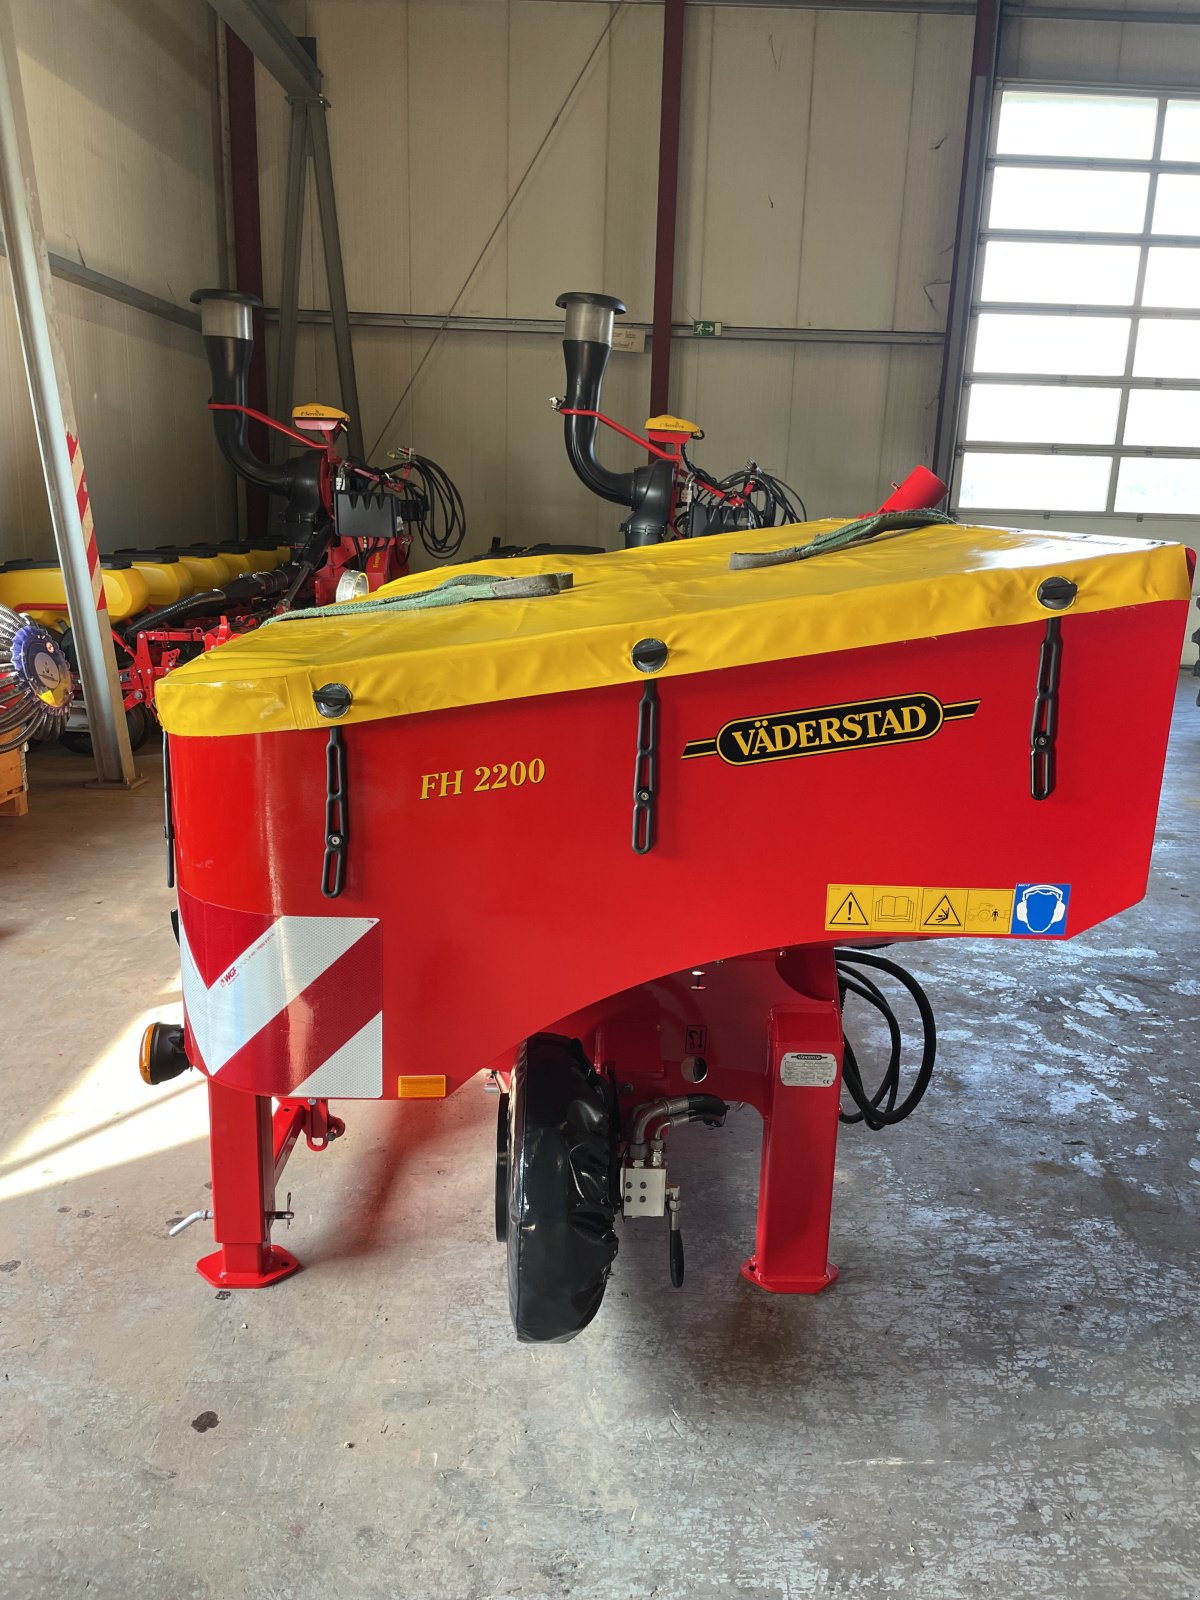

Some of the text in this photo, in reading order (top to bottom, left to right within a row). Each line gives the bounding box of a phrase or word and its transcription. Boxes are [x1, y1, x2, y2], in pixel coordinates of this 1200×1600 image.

[732, 705, 926, 756] VÄDERSTAD
[420, 758, 545, 800] FH 2200
